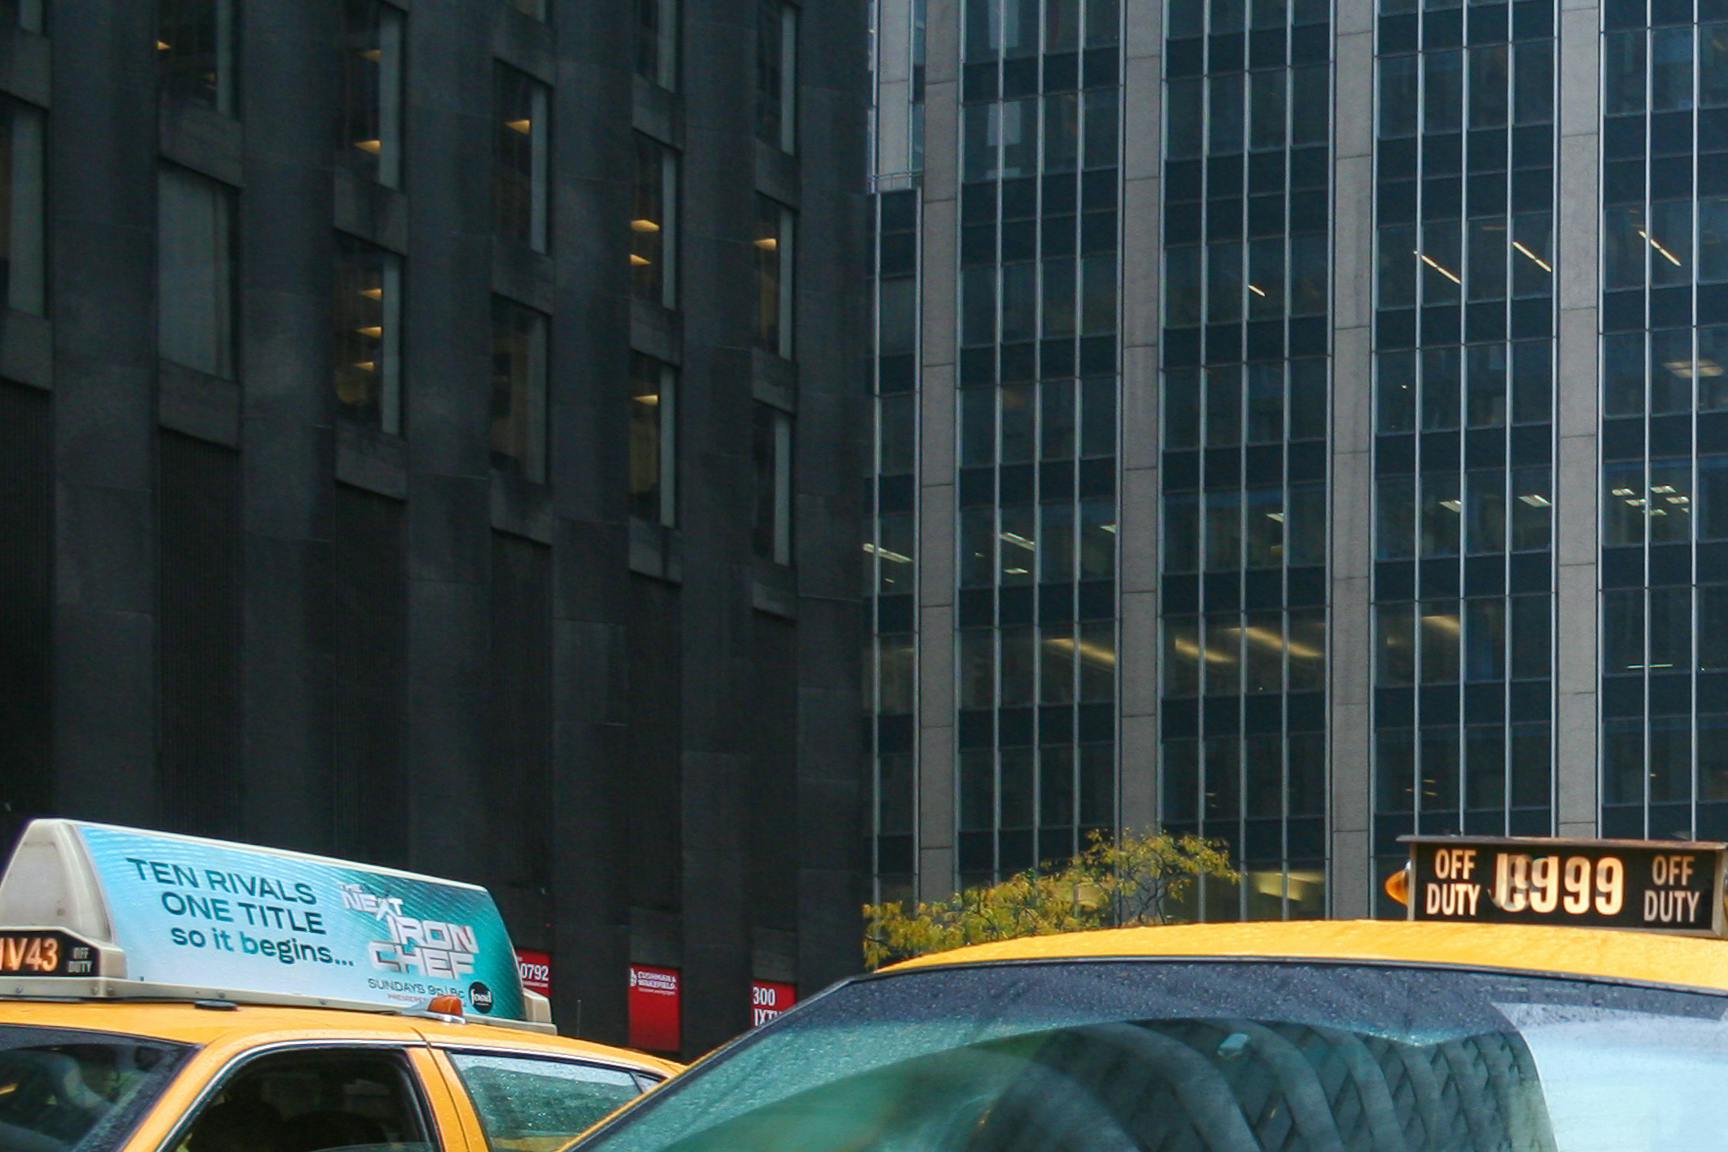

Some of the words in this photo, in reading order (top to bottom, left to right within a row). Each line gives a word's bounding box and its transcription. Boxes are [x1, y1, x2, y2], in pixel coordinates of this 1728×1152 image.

[1435, 849, 1477, 880] OFF
[1652, 856, 1696, 886] OFF
[126, 857, 200, 889] TEN
[205, 869, 317, 906] RIVALS
[161, 891, 234, 923] ONE
[238, 902, 327, 935] TITLE
[340, 891, 404, 921] NEXT
[1426, 883, 1481, 916] DUTY
[1643, 890, 1700, 923] DUTY
[170, 927, 206, 948] so
[212, 928, 235, 951] it
[240, 932, 354, 965] begins...
[386, 915, 480, 954] IRON
[0, 937, 58, 972] V43
[367, 941, 475, 980] CHEF
[368, 978, 426, 994] SUNDAYS
[753, 986, 775, 1006] 300
